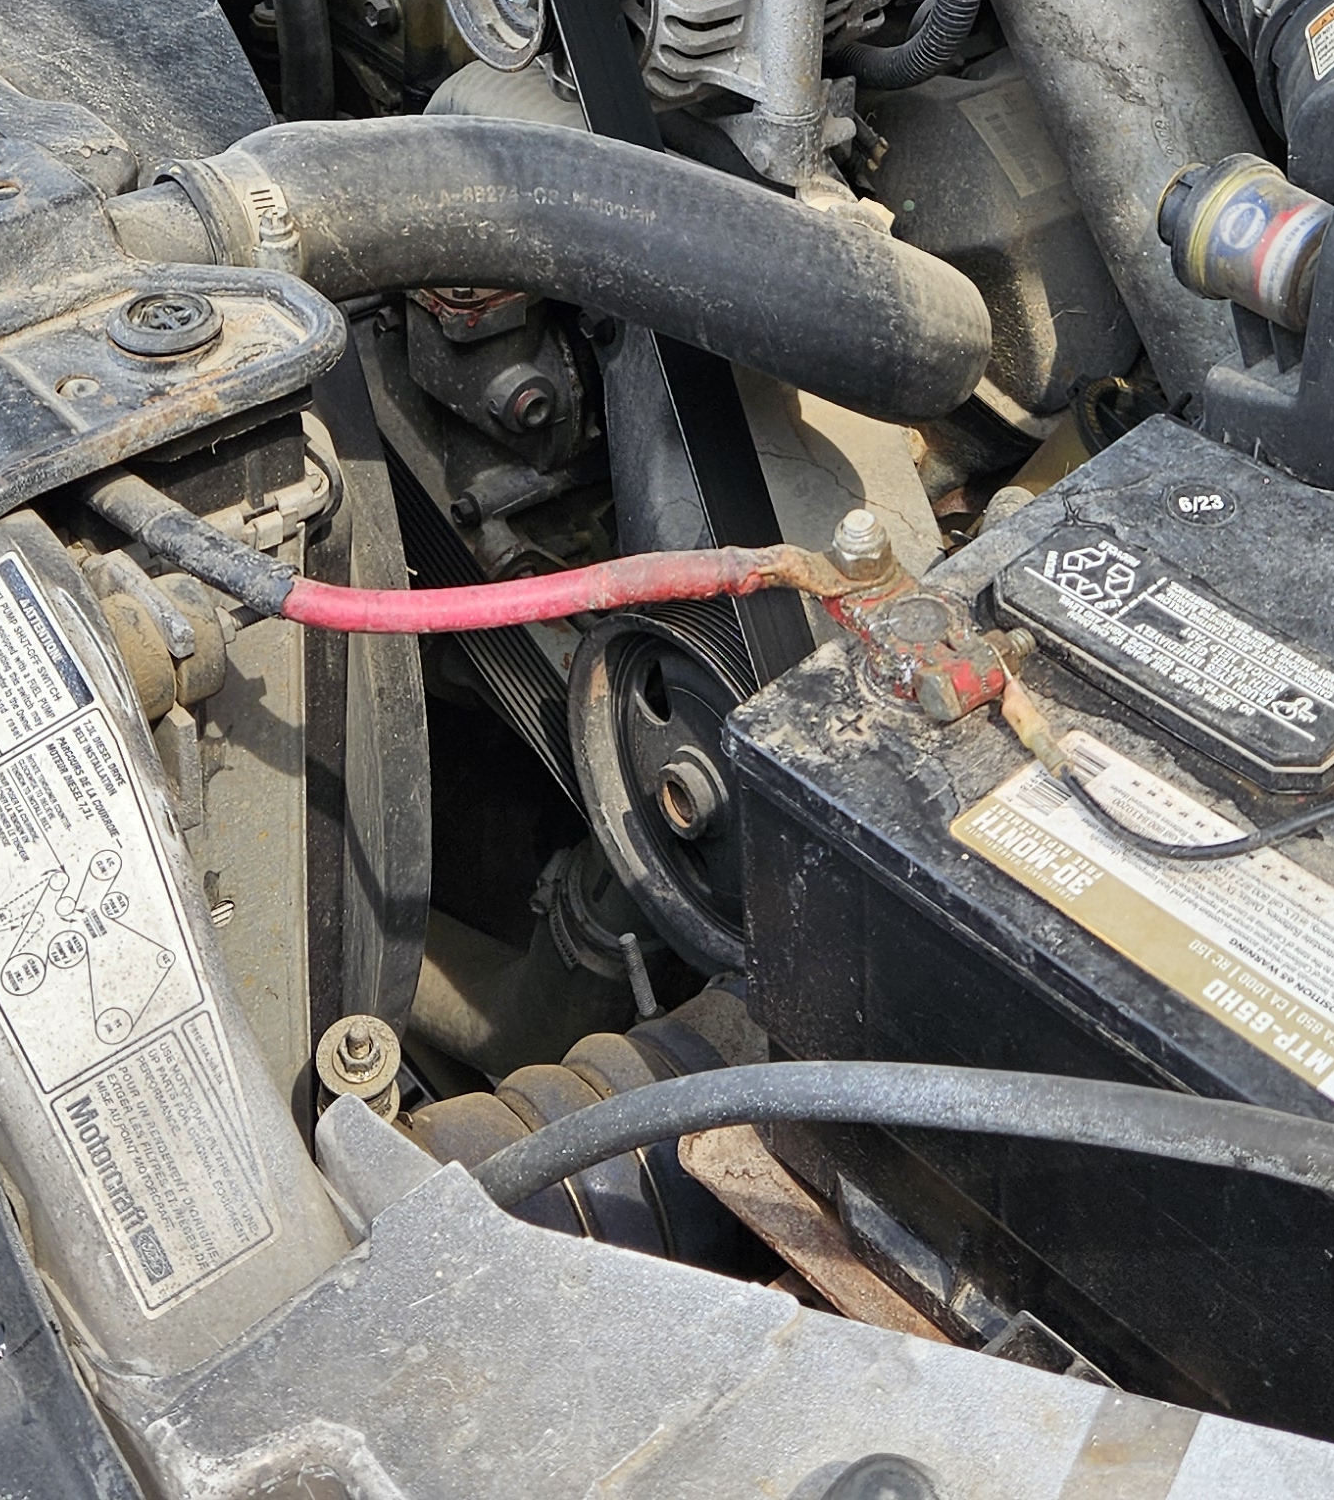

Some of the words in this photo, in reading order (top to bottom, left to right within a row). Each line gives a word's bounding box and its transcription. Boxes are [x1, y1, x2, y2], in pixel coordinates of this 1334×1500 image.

[1177, 494, 1226, 514] 6/23
[22, 603, 64, 664] ATTENTION!
[1178, 624, 1212, 647] FAST
[1182, 637, 1210, 657] GET
[11, 624, 42, 667] SHUT-OFF
[35, 664, 63, 703] SWITCH
[1207, 641, 1241, 663] HELP
[1201, 661, 1236, 685] EYES
[1238, 658, 1290, 691] MEDICAL
[1247, 675, 1281, 699] WITH
[1232, 679, 1271, 706] FLUSH
[54, 733, 86, 777] PARCOURS
[81, 742, 118, 797] INSTALLATION
[90, 734, 113, 764] DIESEL
[106, 761, 127, 787] DRIVE
[61, 772, 85, 802] DIESEL
[988, 801, 1073, 859] REPLACEMENT
[967, 807, 1096, 897] 30-MONTH
[1070, 854, 1106, 880] FREE
[1185, 937, 1216, 960] 150
[1208, 952, 1233, 972] RC
[1226, 936, 1281, 975] WARNING
[1235, 970, 1272, 998] 1000
[1266, 991, 1291, 1011] CA
[157, 1039, 176, 1065] USE
[117, 1063, 141, 1100] POUR
[146, 1046, 162, 1066] UP
[154, 1063, 180, 1102] PARTS
[172, 1099, 192, 1127] FOR
[63, 1091, 150, 1235] Motorcraft
